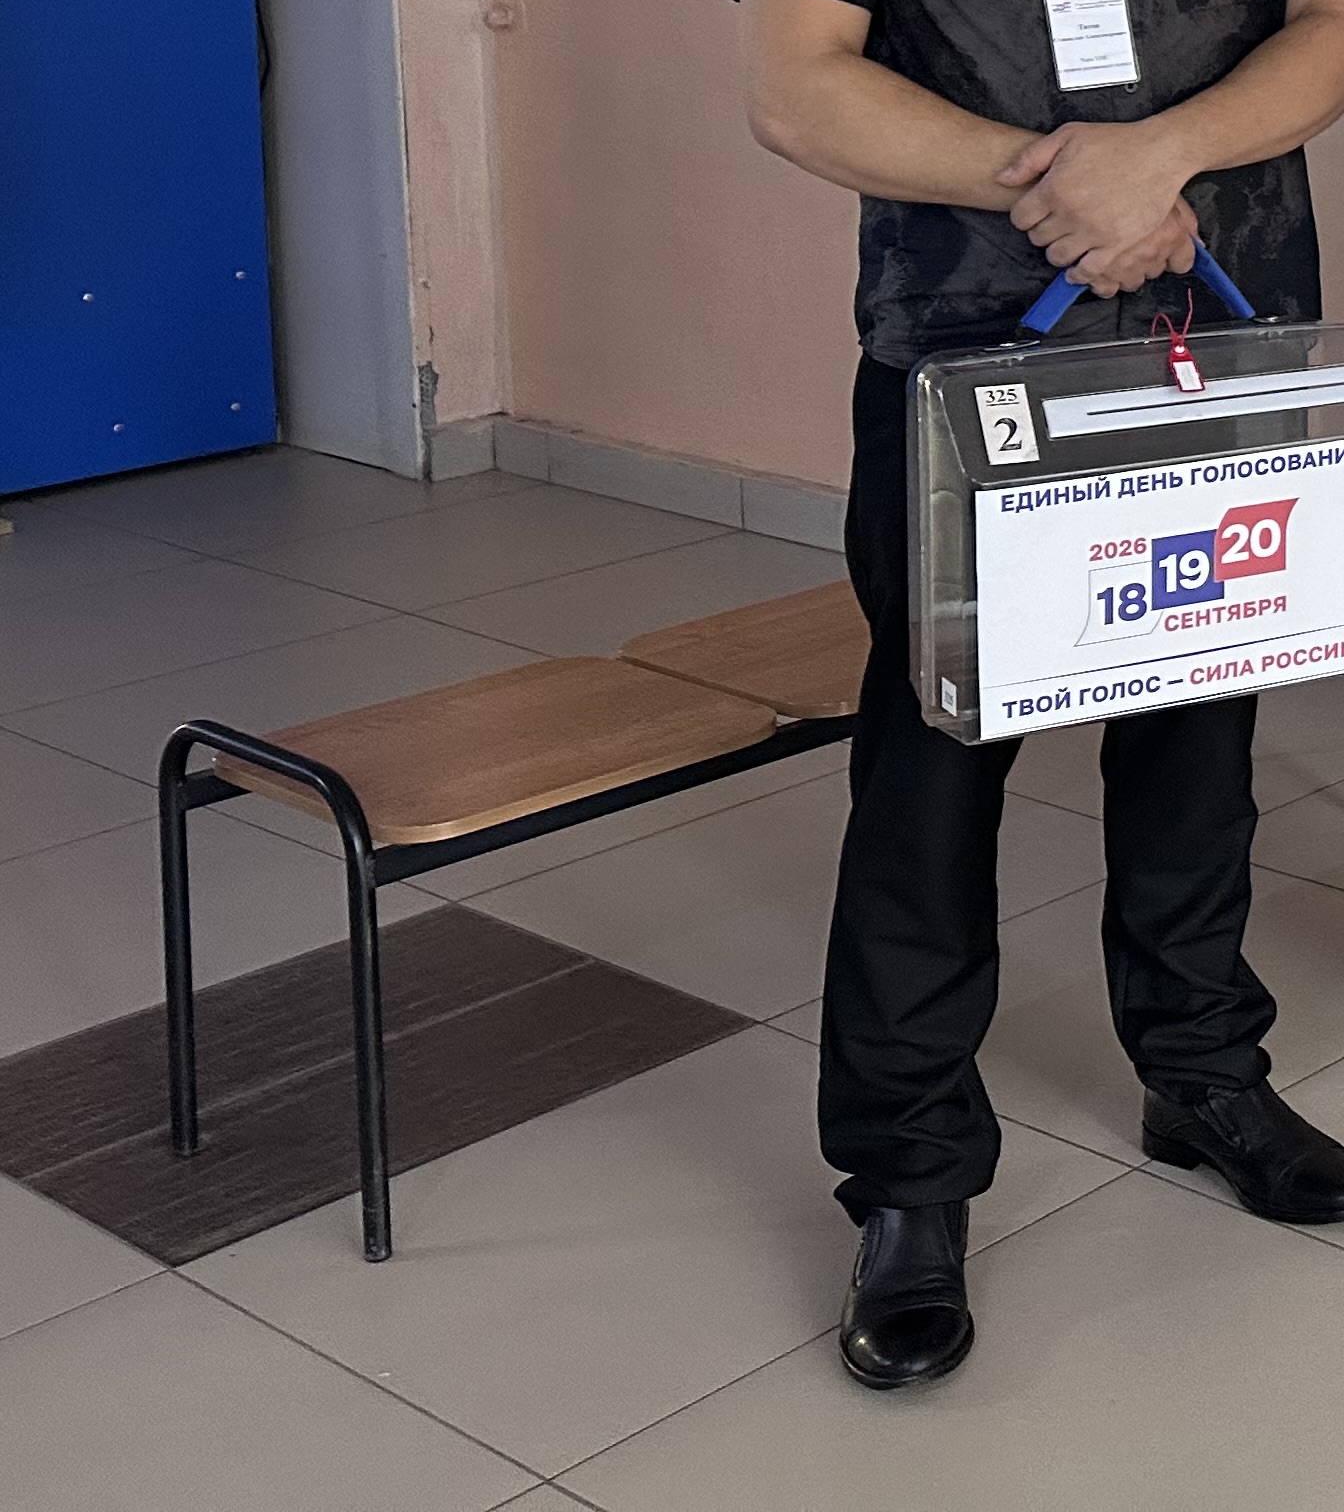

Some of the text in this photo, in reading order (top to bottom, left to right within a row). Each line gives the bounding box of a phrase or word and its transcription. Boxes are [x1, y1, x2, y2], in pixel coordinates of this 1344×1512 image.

[984, 388, 1018, 404] 325
[999, 418, 1022, 452] 2
[1001, 477, 1111, 512] ЕДИНЫЙ
[1118, 465, 1183, 498] ДЕНЬ
[1089, 537, 1147, 561] 2026
[1220, 519, 1282, 564] 20
[1158, 550, 1210, 593] 19
[1097, 582, 1147, 626] 18
[1164, 595, 1287, 632] СЕНТЯБРЯ
[1003, 690, 1071, 719] ТВОЙ
[1079, 675, 1160, 706] ГОЛОС
[1189, 659, 1254, 686] СИЛА
